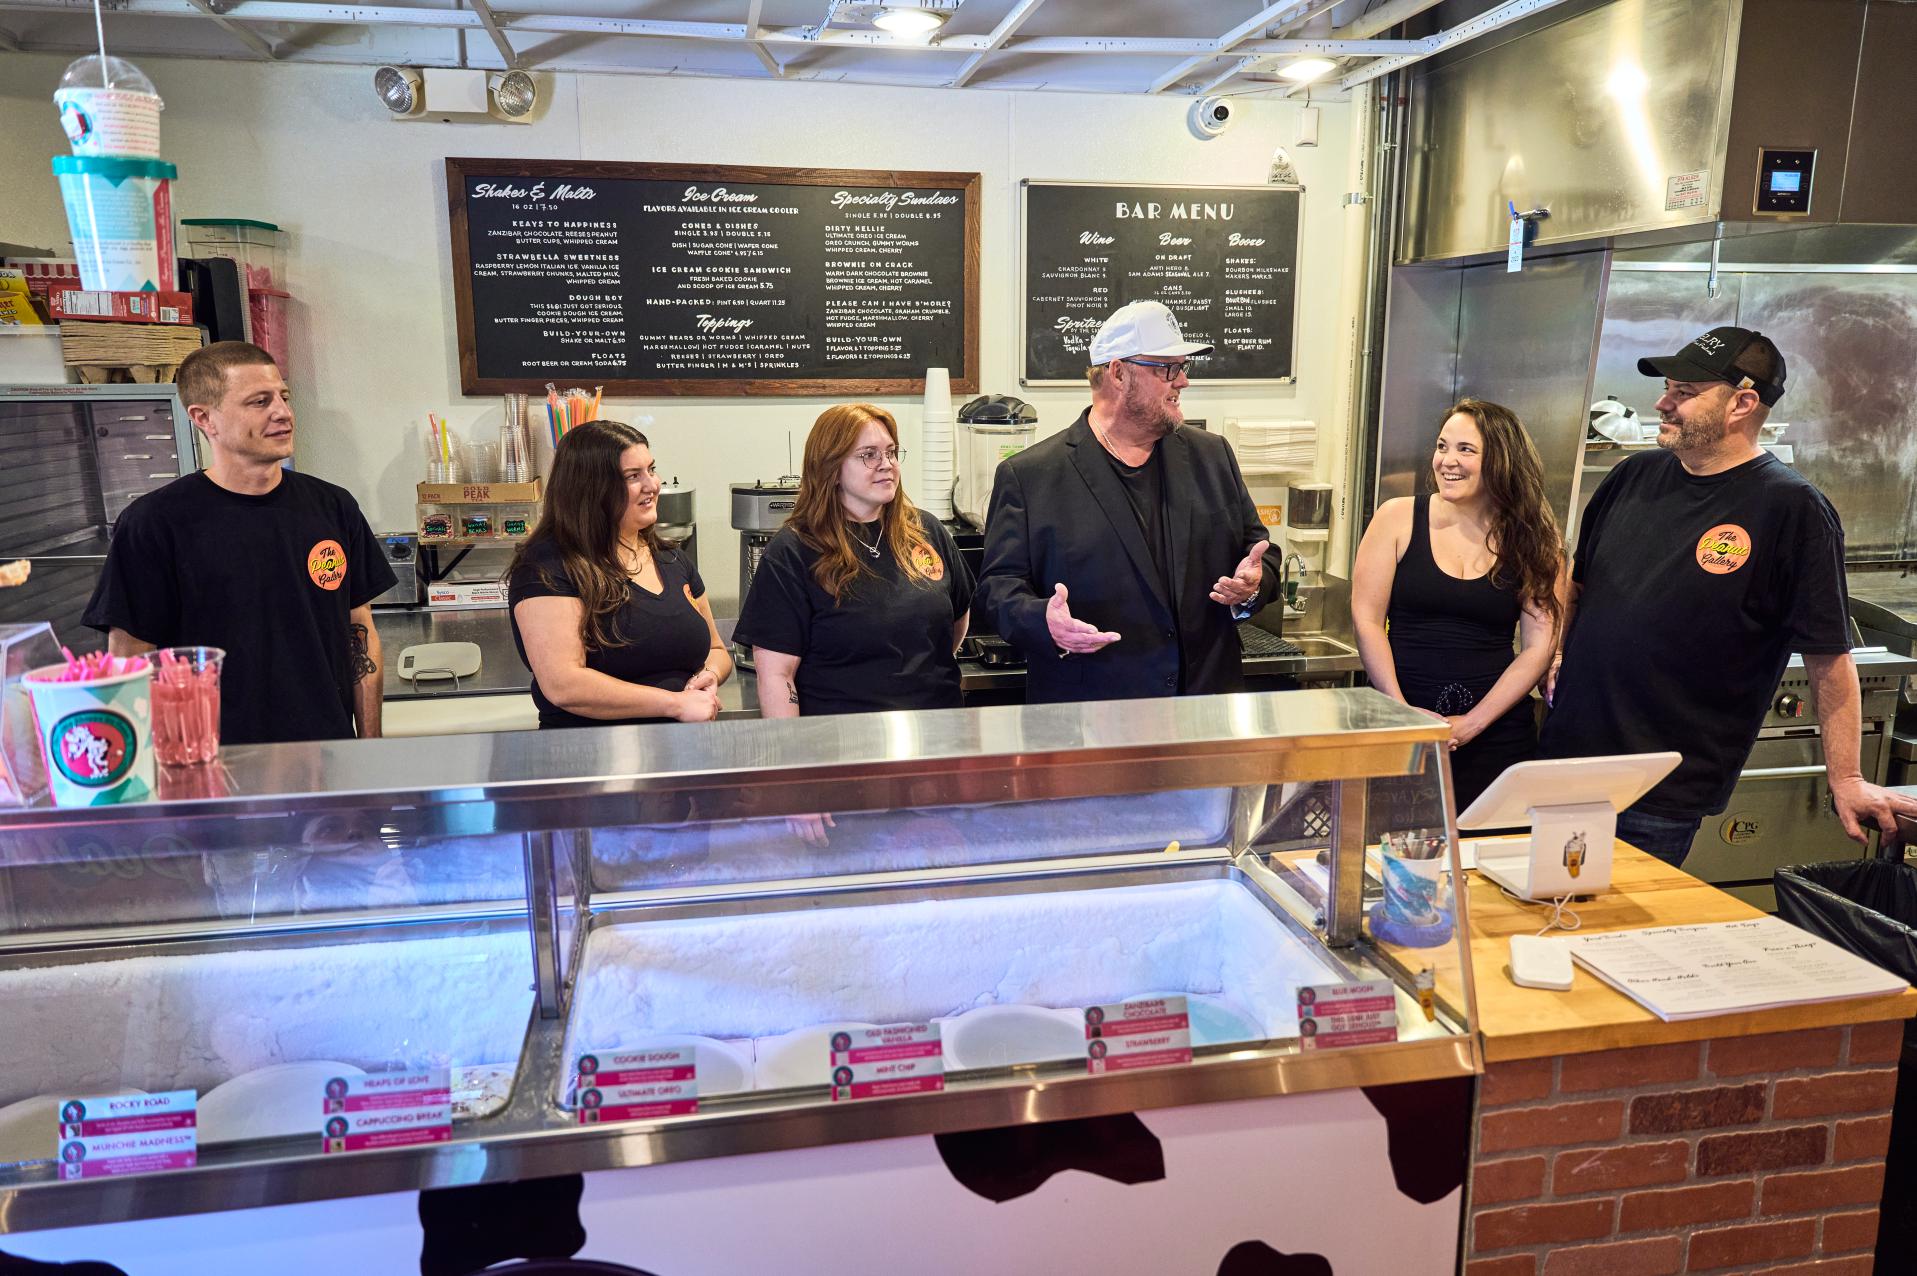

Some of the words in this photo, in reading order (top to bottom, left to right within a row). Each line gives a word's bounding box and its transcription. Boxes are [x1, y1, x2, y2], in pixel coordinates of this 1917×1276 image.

[472, 184, 528, 198] Shakes
[530, 182, 545, 201] &
[549, 184, 596, 200] Malts
[682, 186, 710, 202] Ice
[711, 188, 758, 202] Cream
[831, 191, 899, 211] Specialty
[897, 191, 958, 205] Sundaes
[1116, 202, 1161, 218] BAR
[1170, 203, 1233, 220] MENU
[1080, 231, 1114, 244] Wine
[1159, 232, 1192, 245] Beer
[1229, 233, 1265, 246] Booze
[696, 314, 753, 333] Toppings
[1064, 335, 1083, 345] Vodka
[464, 491, 490, 499] PEAK
[1719, 531, 1737, 541] The
[320, 547, 336, 558] The
[1699, 537, 1749, 556] Peanut
[1701, 553, 1738, 570] Gallery
[1735, 820, 1758, 833] CPG
[109, 1100, 141, 1110] ROCKY
[144, 1098, 170, 1106] ROAD
[93, 1140, 136, 1152] MUNCHIE
